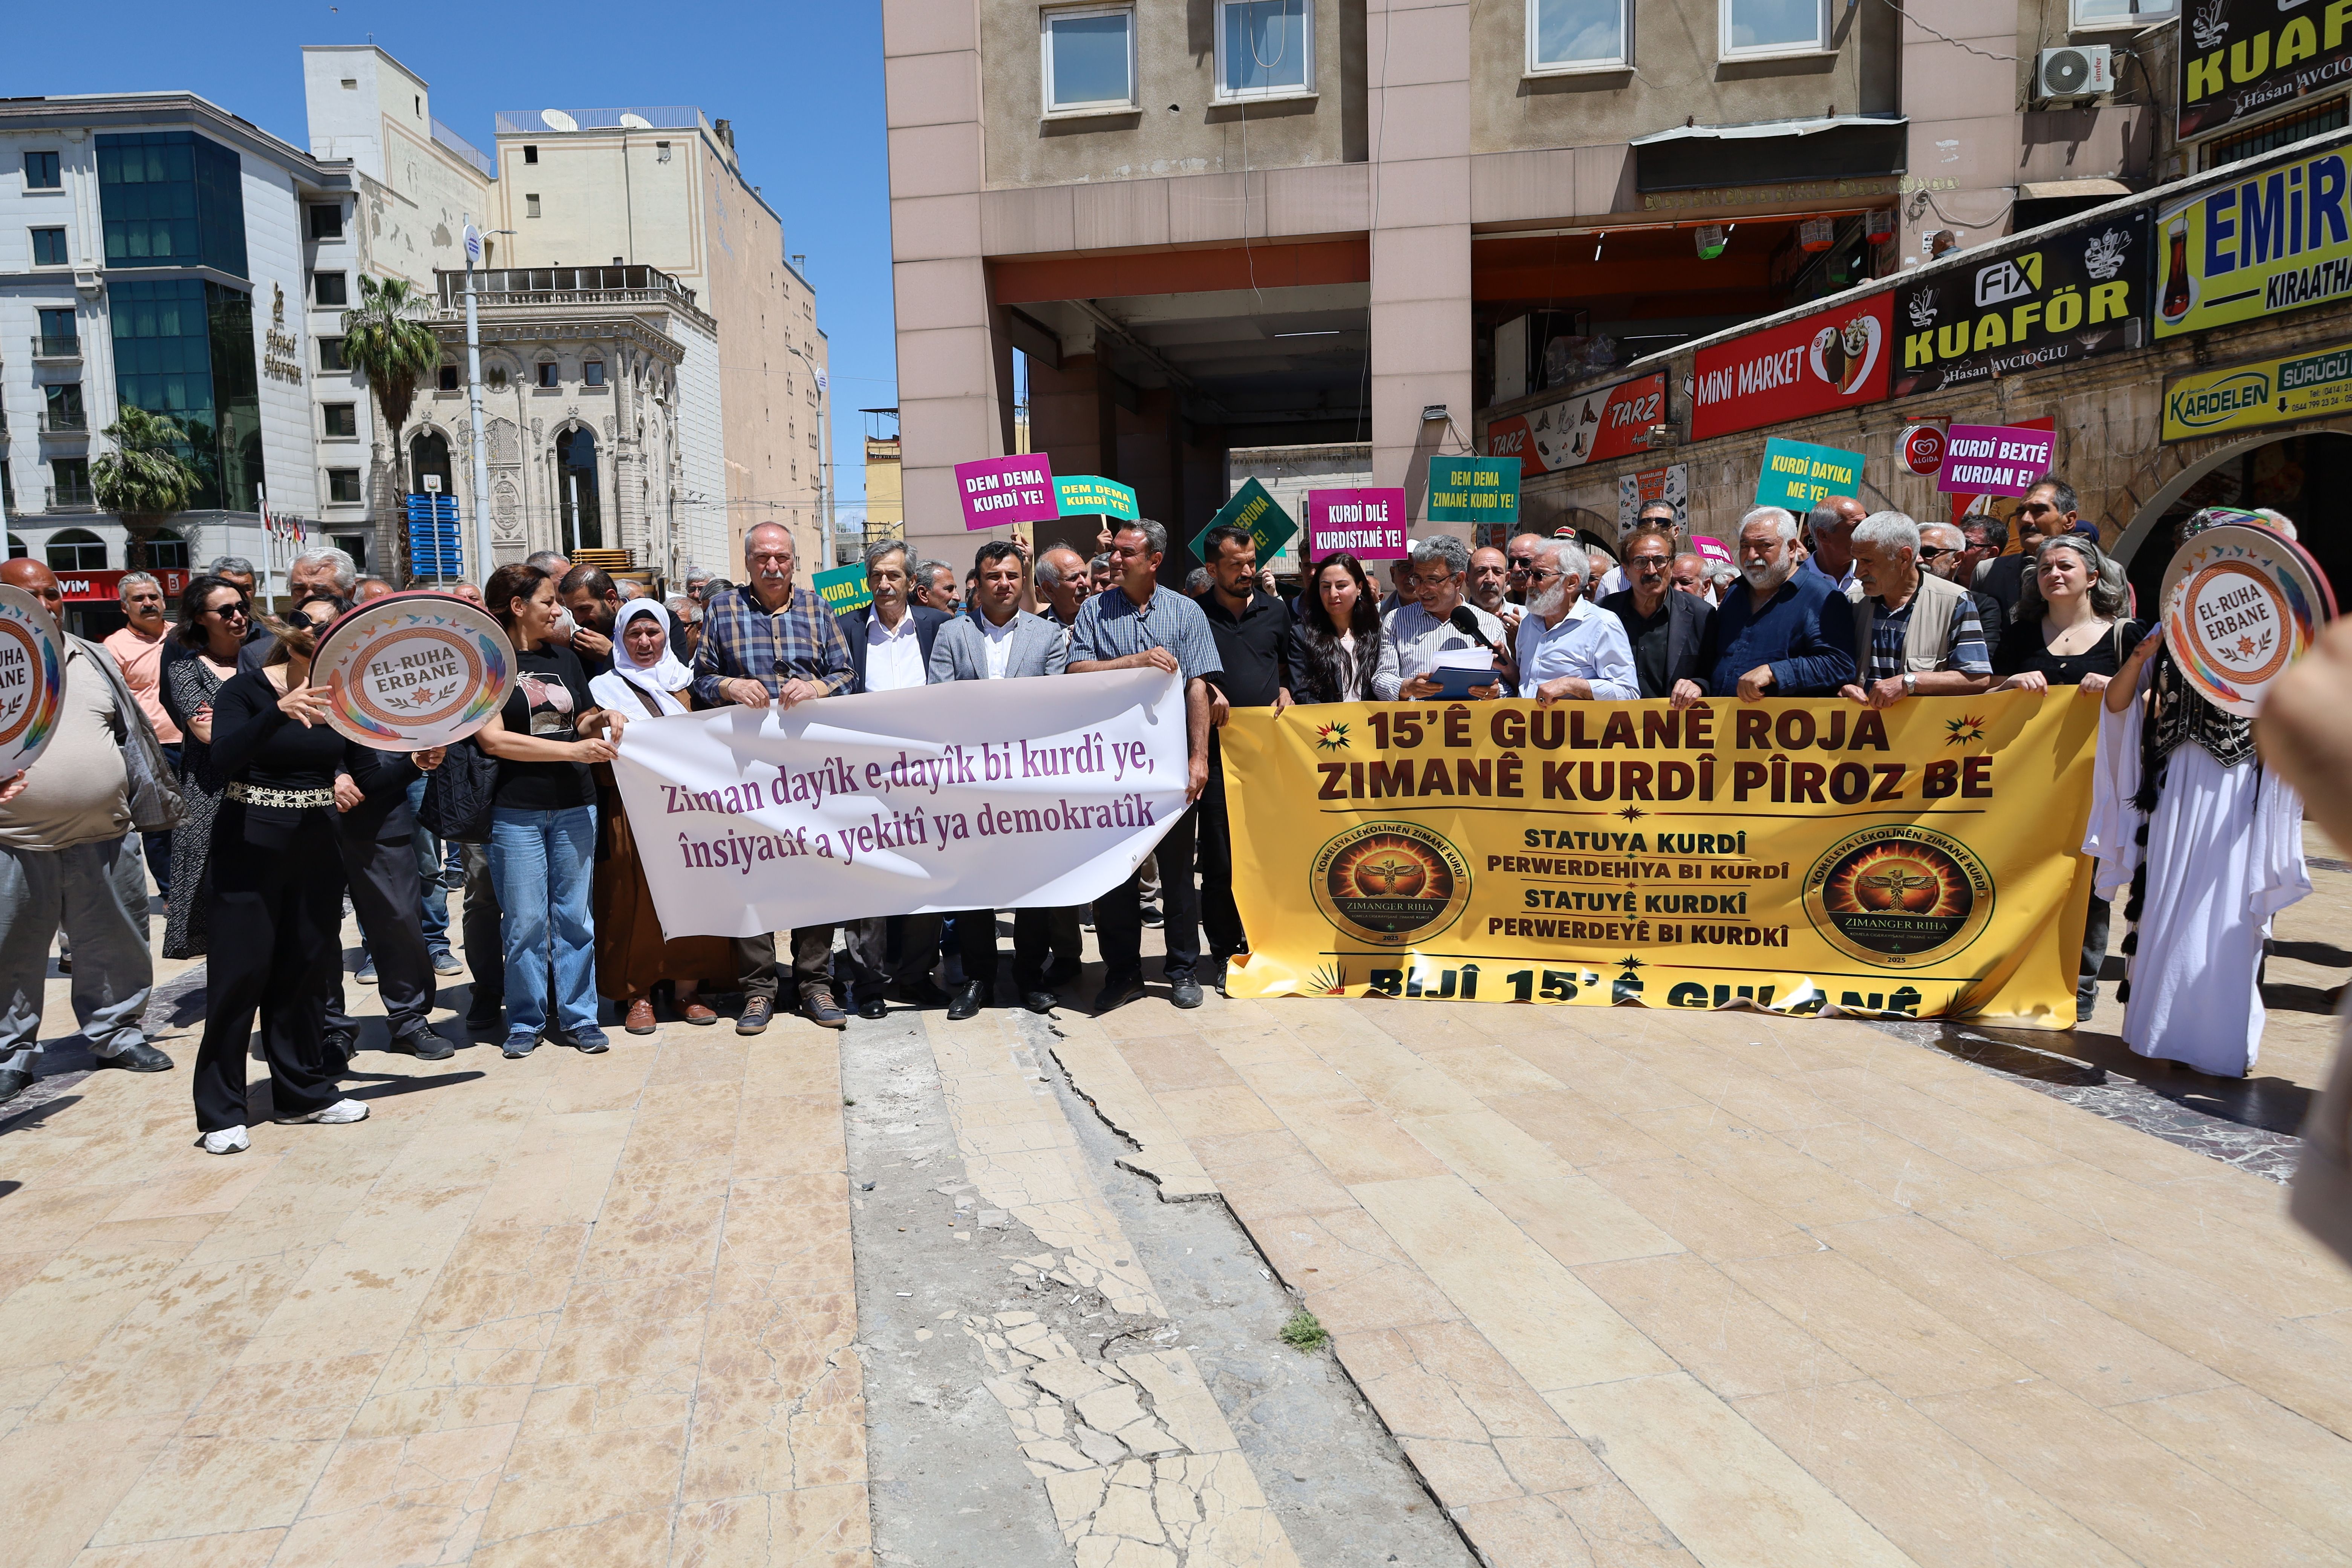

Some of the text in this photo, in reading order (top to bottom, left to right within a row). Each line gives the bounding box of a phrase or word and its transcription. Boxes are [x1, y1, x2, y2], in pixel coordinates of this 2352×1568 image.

[2244, 83, 2292, 109] Hasan
[1905, 280, 2129, 368] KUAFÖR
[266, 328, 297, 351] Hotel
[265, 353, 302, 378] Harran
[1738, 345, 1805, 397] MARKET
[1949, 345, 2068, 382] Hasan AVCIOĞLU
[2283, 352, 2348, 387] SÜRÜCÜ
[1611, 392, 1661, 429] TARZ
[2170, 381, 2269, 422] KARDELEN
[1493, 429, 1526, 456] TARZ
[1949, 437, 2049, 464] KURDÎ BEXTÊ
[966, 470, 1044, 493] DEM DEMA
[1451, 471, 1499, 486] DEM DEMA
[1771, 455, 1852, 485] KURDÎ DAYIKA
[1951, 464, 2034, 488] KURDAN E!
[973, 489, 1044, 513] KURDÎ YE!
[1061, 484, 1130, 503] DEM DEMA
[1433, 490, 1514, 508] ZIMANÊ KURDÎ YE!
[1786, 481, 1807, 499] ME
[1066, 495, 1130, 513] KURDÎ YE!
[1233, 496, 1269, 530] EBÛNA
[1329, 500, 1389, 523] KURDÎ DILÊ
[1316, 526, 1402, 550] KURDISTANÊ YE!
[821, 582, 859, 602] KURD,
[2197, 584, 2262, 621] EL-RUHA
[2205, 603, 2270, 641] ERBANE
[371, 647, 455, 677] EL-RUHA
[375, 662, 458, 693] ERBANE
[1367, 701, 1890, 751] 15'Ê GULANÊ ROJA
[660, 780, 764, 814] Ziman
[772, 756, 859, 810] dayîk
[981, 742, 1013, 781] bi
[1019, 732, 1105, 778] kurdî
[1111, 741, 1154, 781] ye,
[1317, 752, 1993, 804] ZIMANÊ KURDÎ PÎROZ BE
[678, 826, 809, 875] însiyatîf
[815, 834, 834, 858] a
[933, 812, 970, 851] ya
[977, 793, 1155, 836] demokratîk
[1524, 829, 1747, 854] STATUYA KURDÎ
[1413, 830, 1450, 852] ZIMANÊ
[1445, 852, 1466, 878] KURDÎ
[1487, 855, 1790, 879] PERWERDEHIYA BI KURDÎ
[1925, 835, 1971, 864] ZIMANÊ
[1965, 860, 1988, 891] KURDÎ
[1524, 889, 1747, 914] STATUYÊ KURDKÎ
[1488, 917, 1790, 947] PERWERDEYÊ BI KURDKÎ
[1845, 918, 1948, 930] ZIMANGER RIHA
